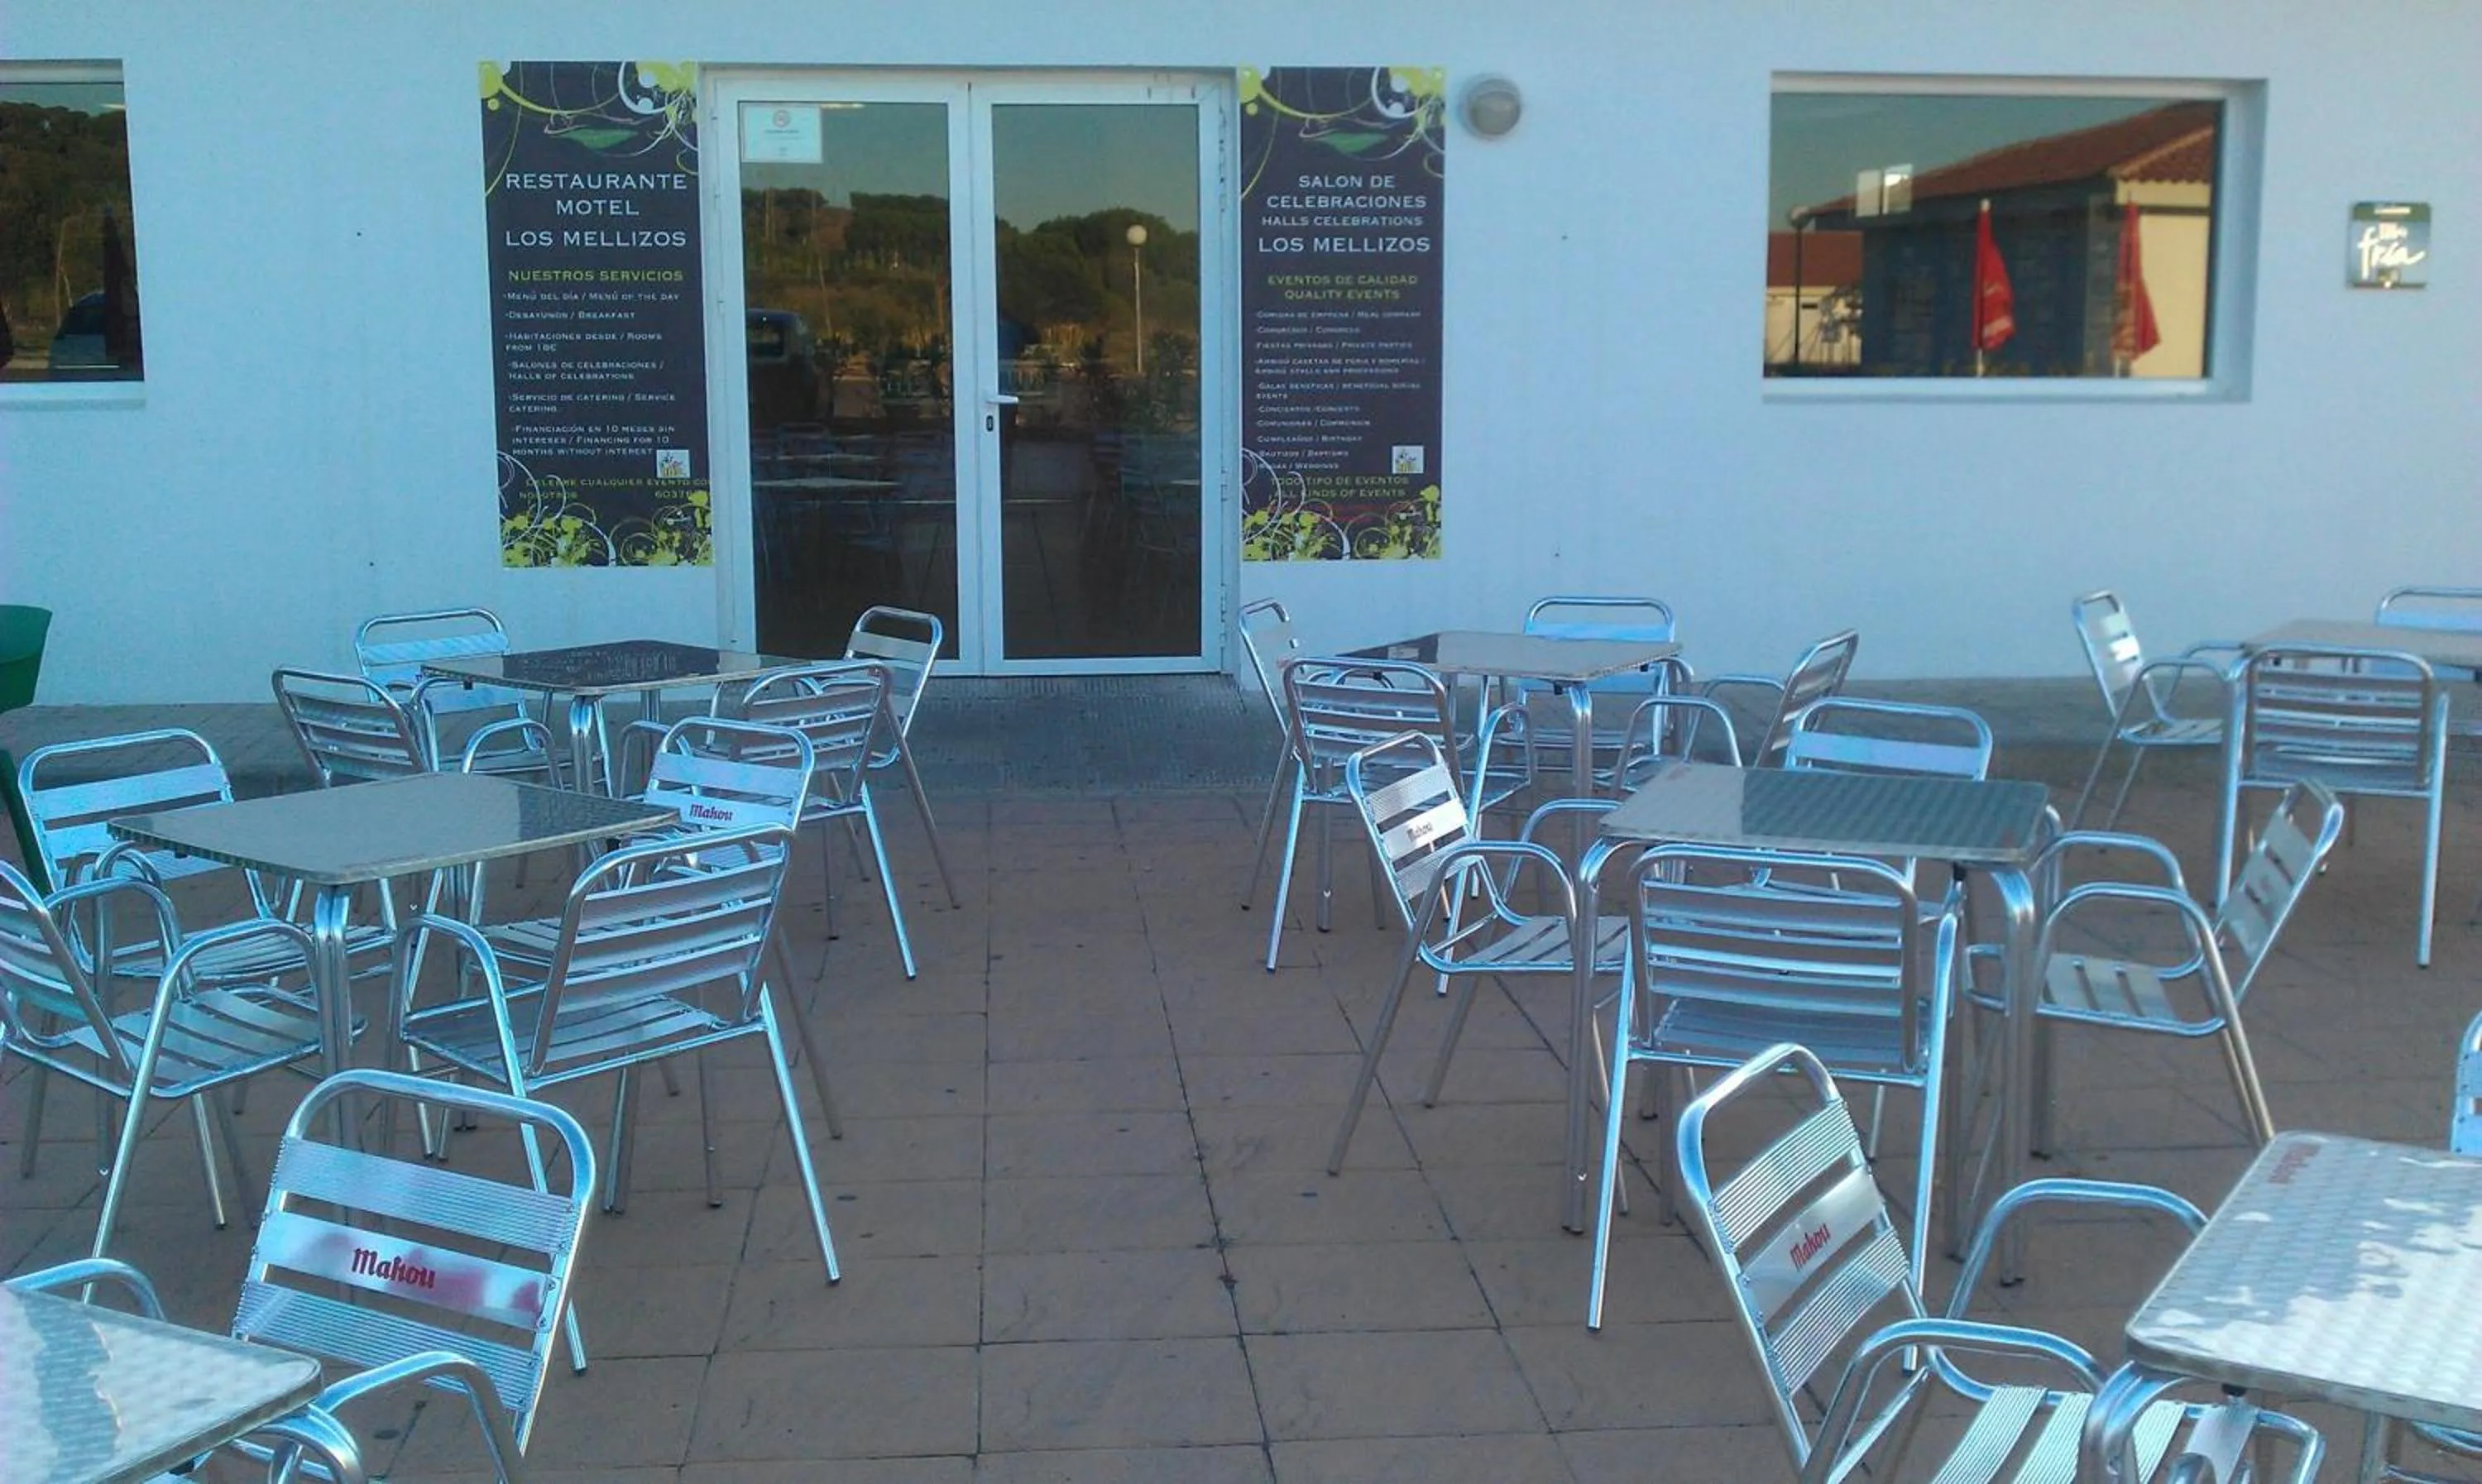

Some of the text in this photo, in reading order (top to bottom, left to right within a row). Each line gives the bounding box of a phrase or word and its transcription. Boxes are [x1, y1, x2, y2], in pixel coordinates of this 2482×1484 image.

[506, 173, 688, 190] RESTAURANTE
[1298, 175, 1395, 189] SALON DE
[556, 199, 640, 216] MOTEL
[1267, 195, 1427, 208] CELEBRACIONES
[1262, 216, 1423, 226] HALLS CELEBRATIONS
[506, 231, 686, 247] LOS MELLIZOS
[1258, 237, 1430, 252] LOS MELLIZOS
[509, 270, 684, 282] NUESTROS SERVICIOS
[1267, 275, 1417, 285] EVENTOS DE CALIDAD
[1285, 290, 1400, 299] QUALITY EVENTS
[351, 1247, 437, 1289] Mahou
